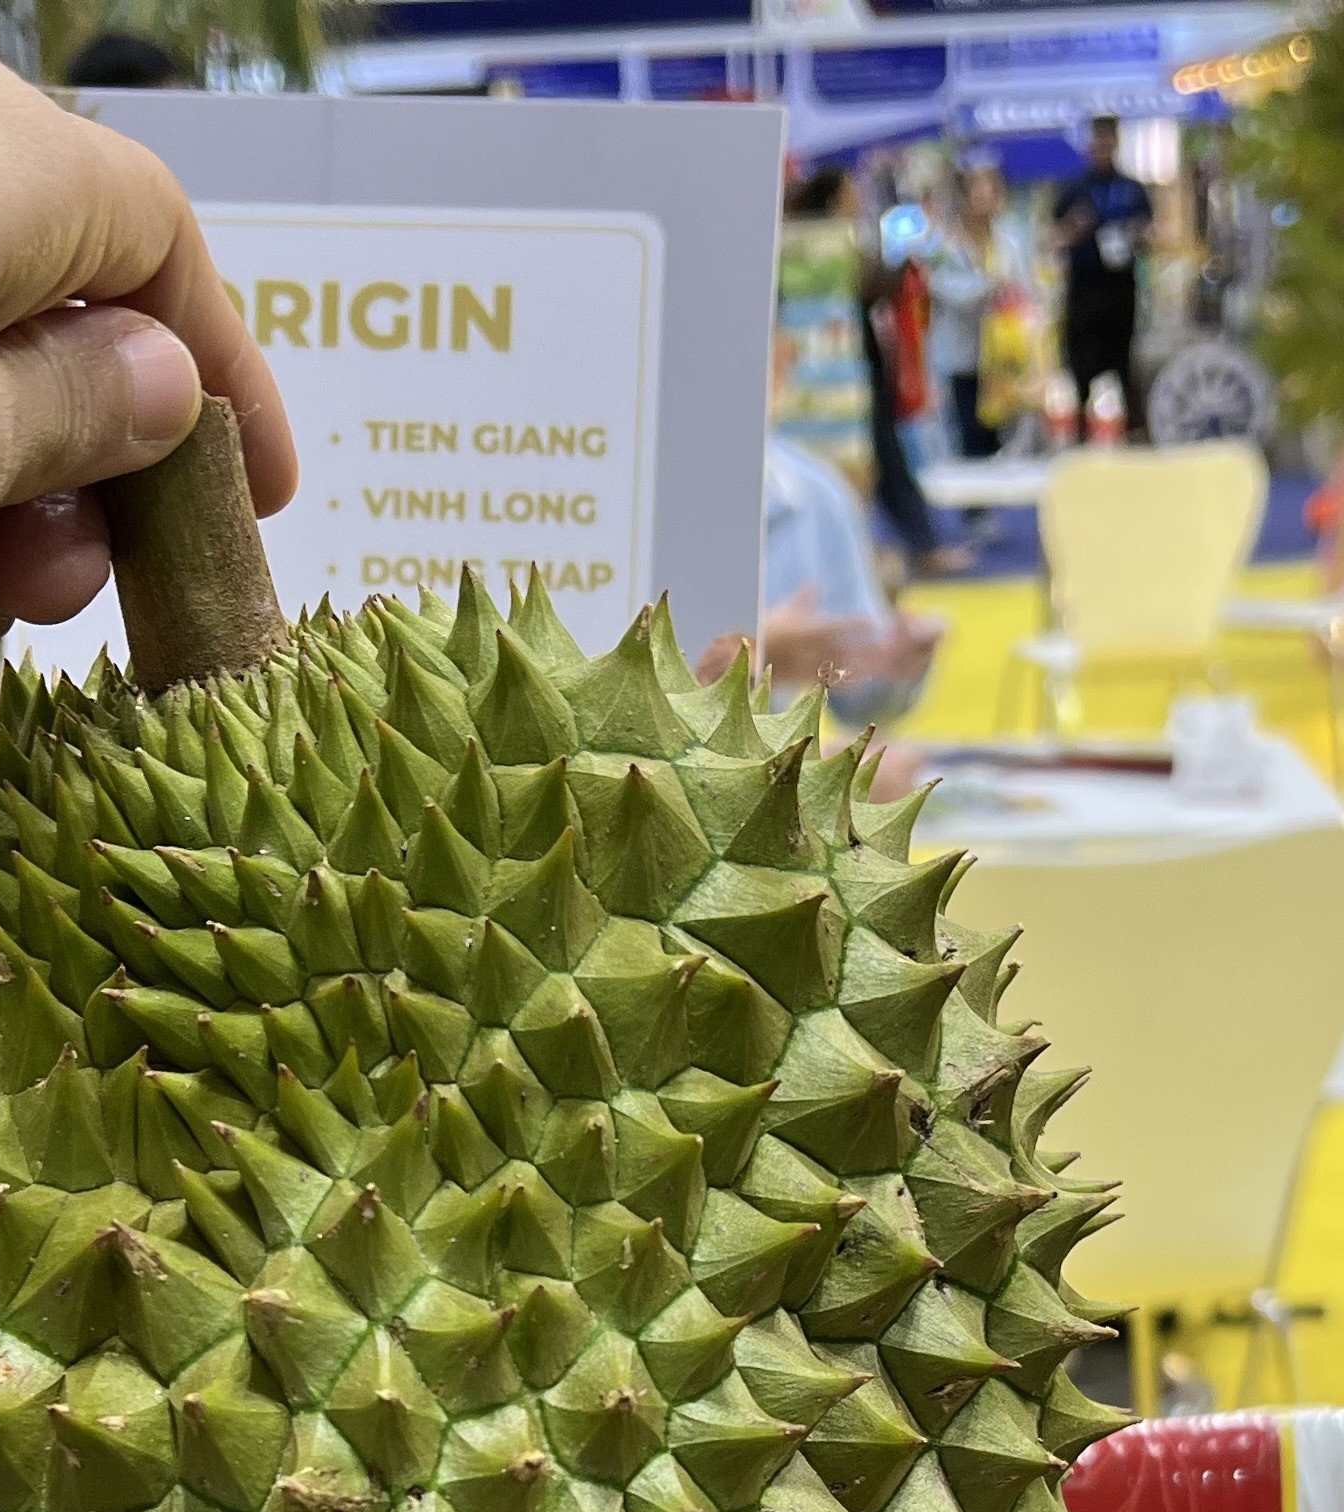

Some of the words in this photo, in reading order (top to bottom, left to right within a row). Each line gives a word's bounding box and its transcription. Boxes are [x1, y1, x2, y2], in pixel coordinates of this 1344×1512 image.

[223, 279, 513, 352] RIGIN
[363, 419, 457, 453] TIEN
[471, 423, 608, 458] GIANG
[361, 487, 466, 521] VINH
[480, 491, 597, 526] LONG
